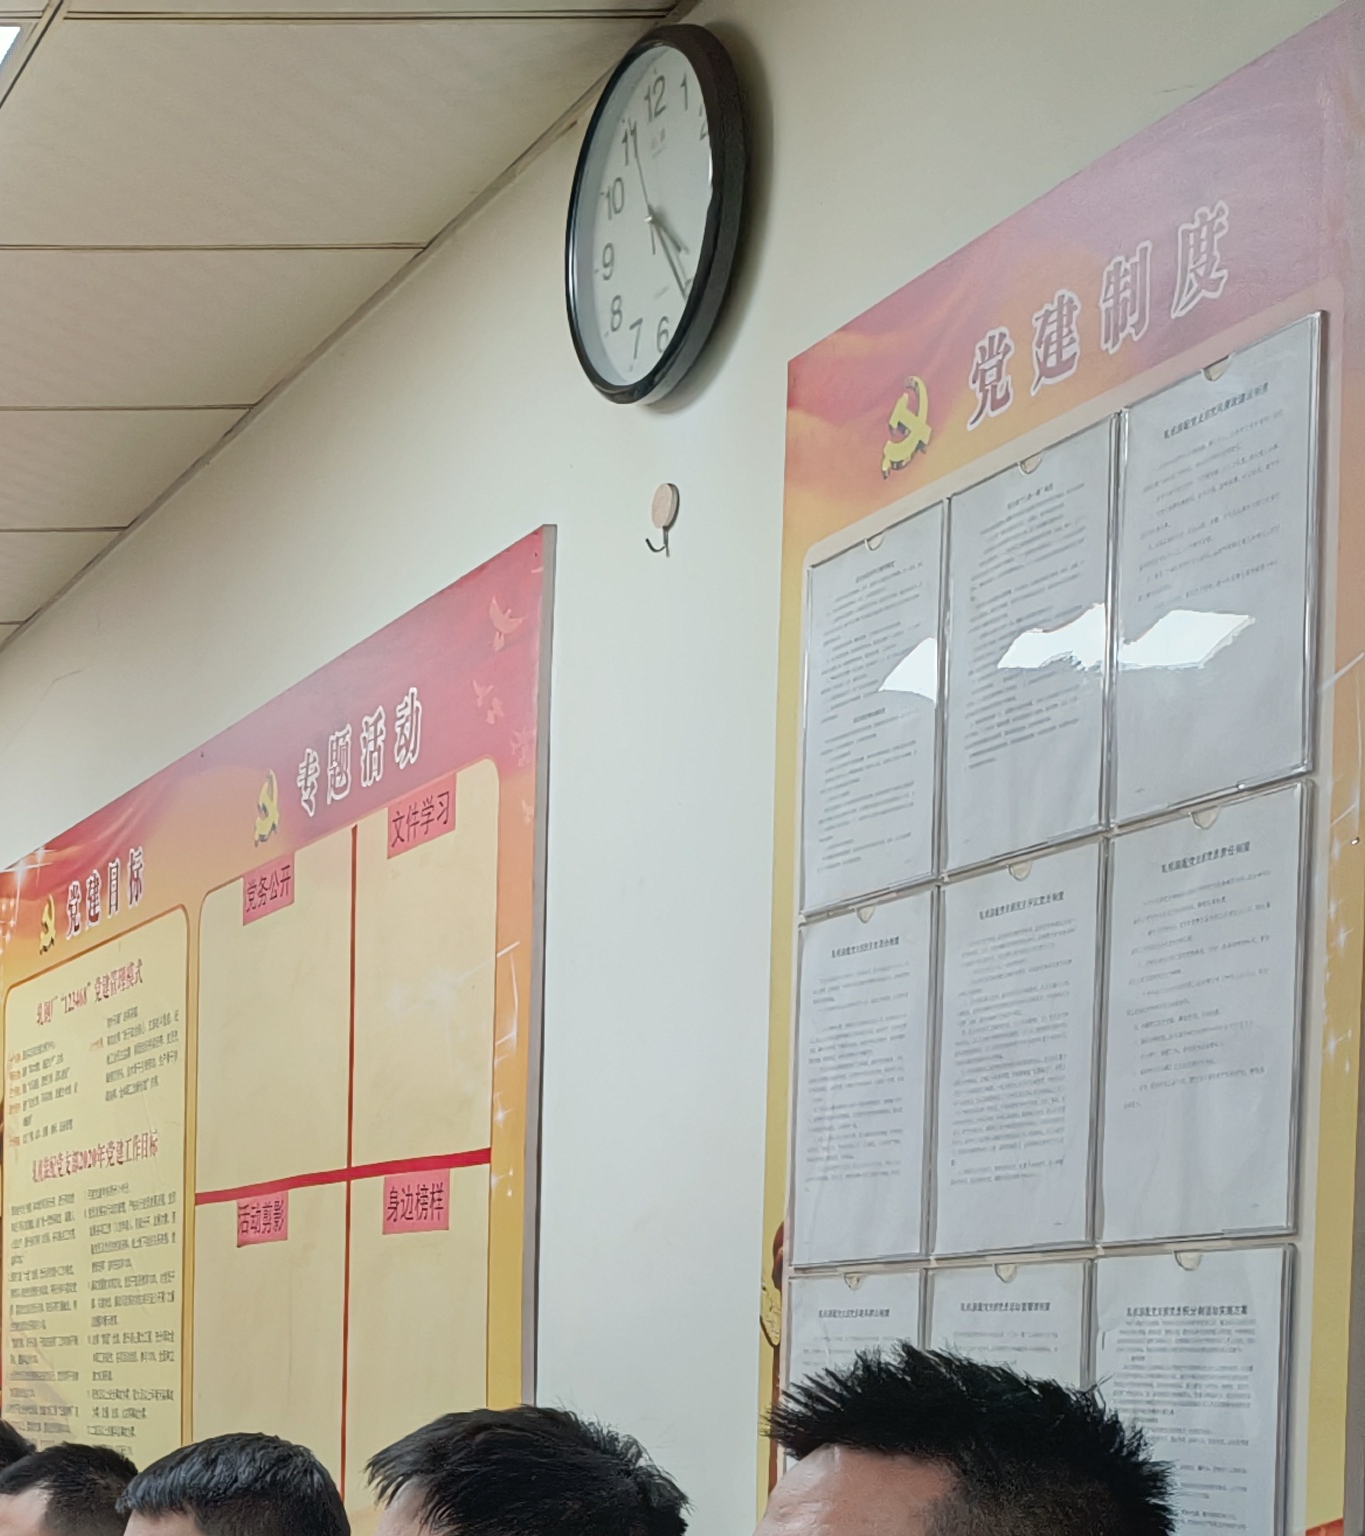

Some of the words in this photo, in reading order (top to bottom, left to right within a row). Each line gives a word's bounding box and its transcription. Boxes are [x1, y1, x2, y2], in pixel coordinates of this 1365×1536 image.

[643, 74, 667, 123] 12
[680, 71, 688, 111] 1
[605, 177, 626, 221] 10
[602, 242, 614, 281] 9
[610, 294, 623, 333] 8
[968, 201, 1229, 431] 党建制度
[629, 317, 644, 360] 7
[296, 687, 423, 817] 专题活动
[391, 790, 451, 848] 文件学习
[66, 847, 145, 940] 党建目标
[245, 864, 292, 914] 党务公开
[237, 1199, 285, 1236] 活动剪影
[386, 1182, 444, 1223] 身边榜样
